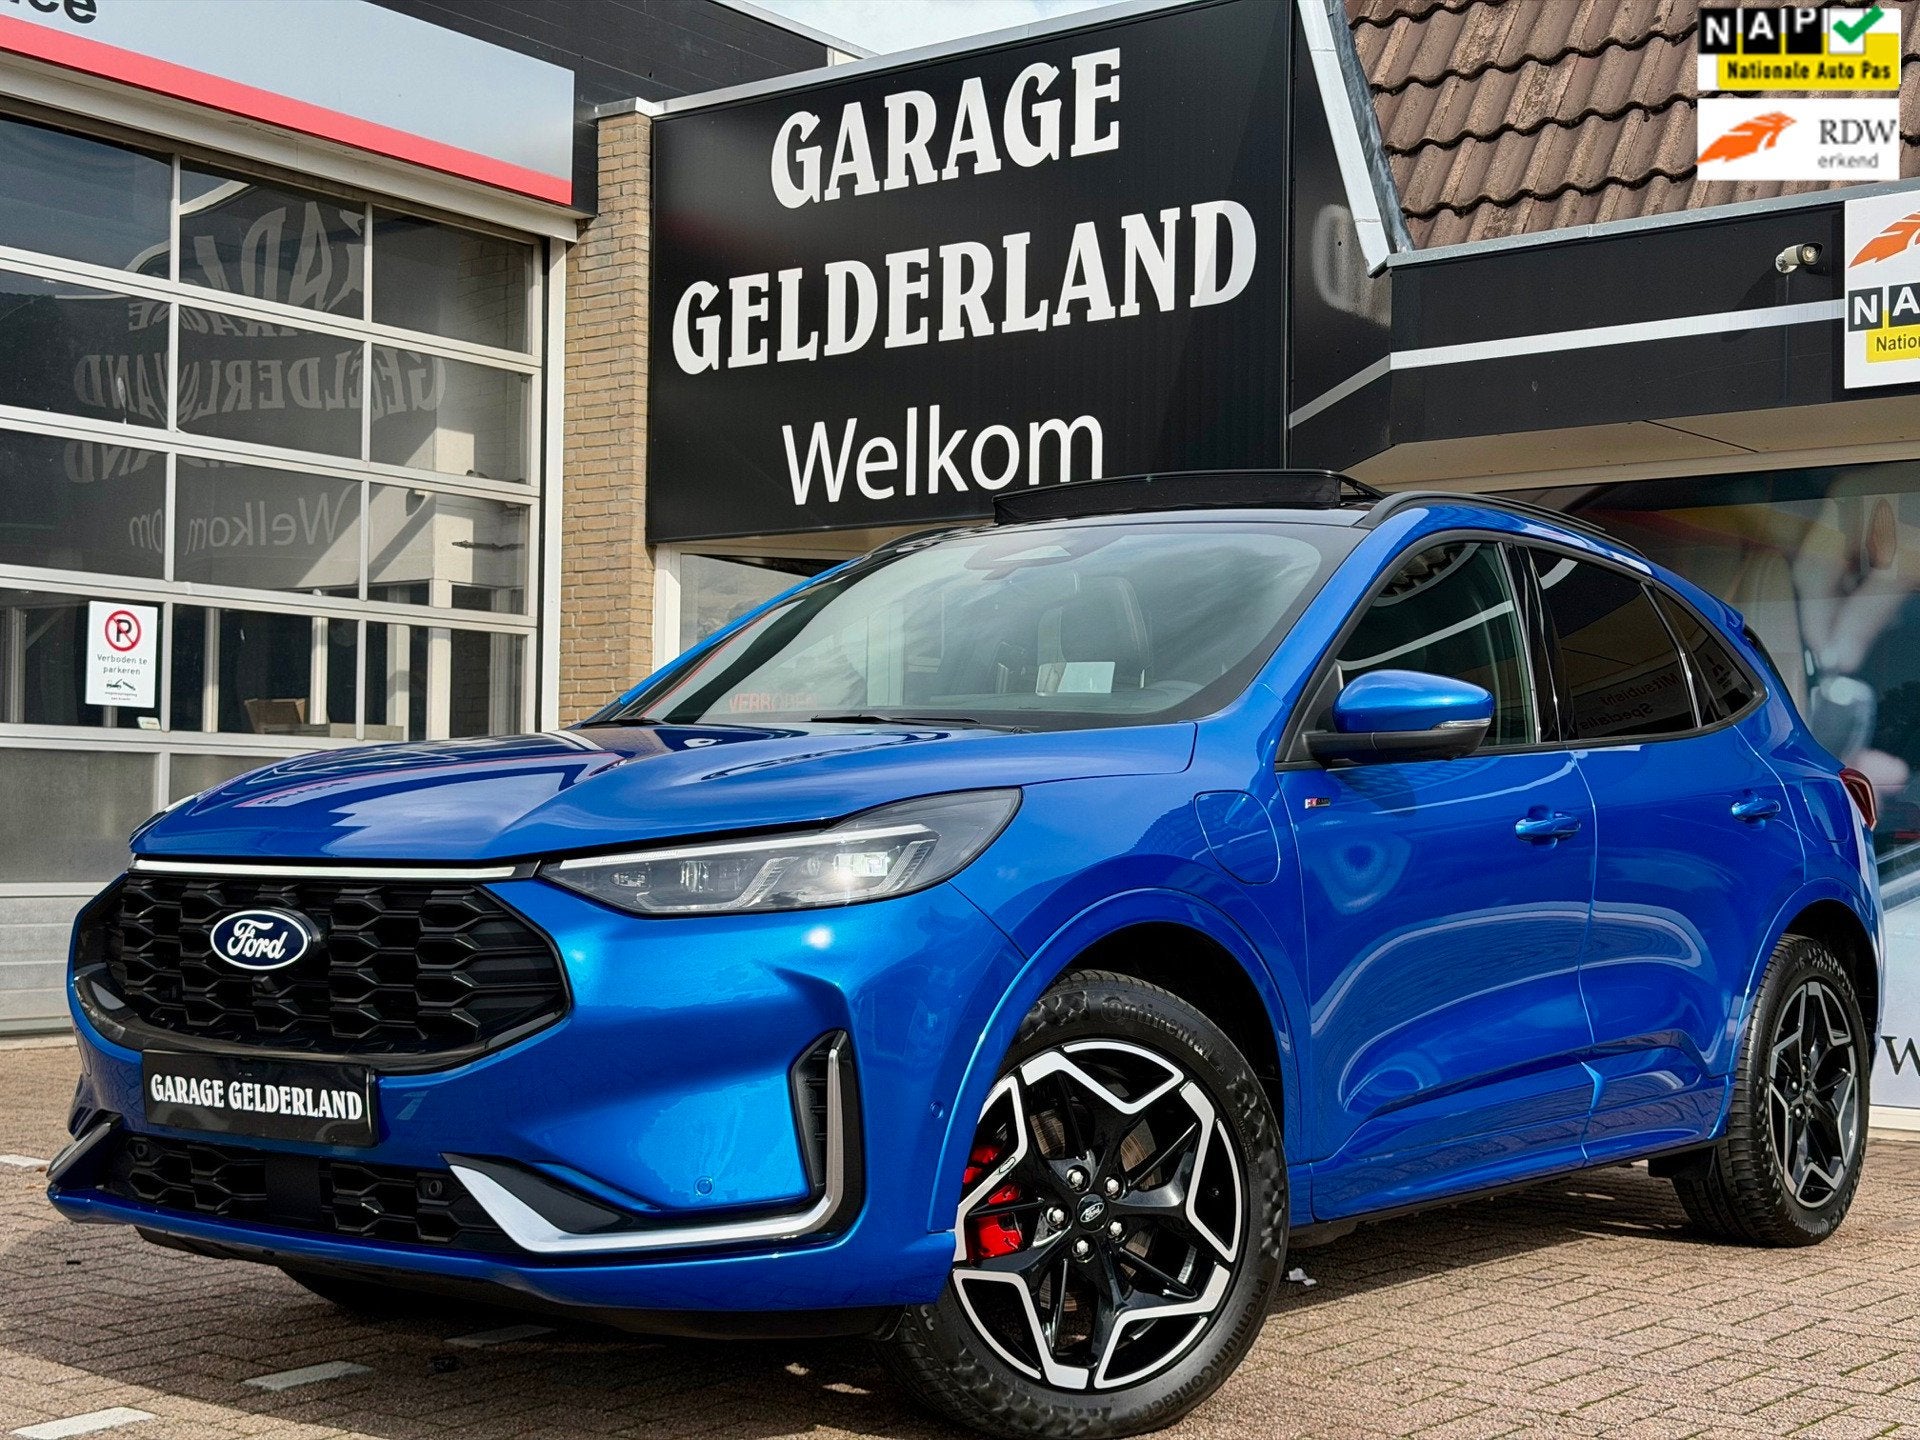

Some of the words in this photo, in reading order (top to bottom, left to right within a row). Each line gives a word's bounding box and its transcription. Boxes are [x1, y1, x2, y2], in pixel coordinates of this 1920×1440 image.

[770, 47, 1121, 209] GARAGE
[671, 200, 1257, 375] GELDERLAND
[782, 404, 1103, 506] Welkom
[97, 654, 137, 665] Verboden
[138, 657, 148, 666] te
[103, 666, 141, 676] parkeren
[228, 918, 288, 960] Ford
[150, 1074, 225, 1109] GARAGE
[228, 1081, 363, 1121] GELDERLAND
